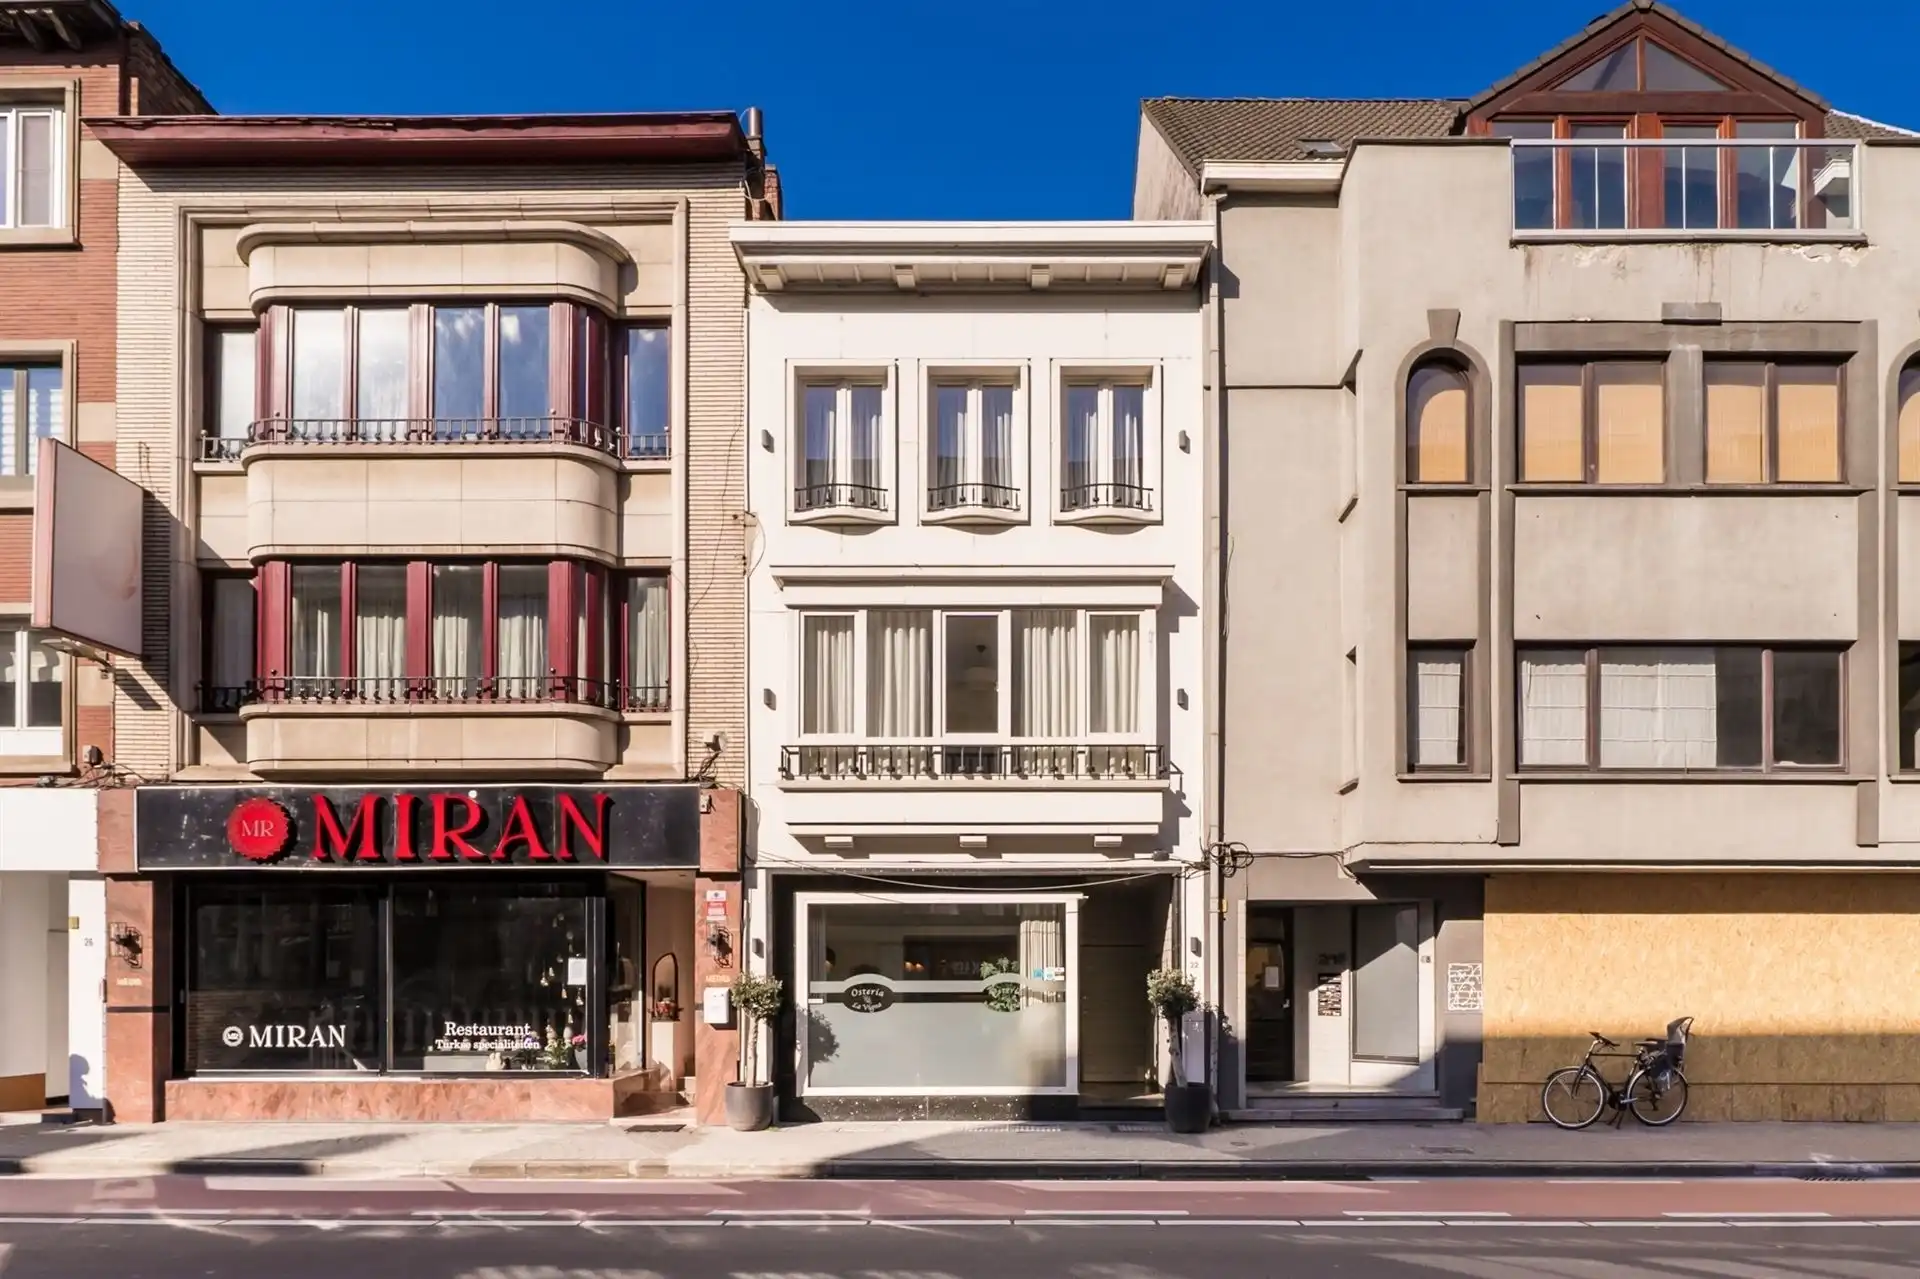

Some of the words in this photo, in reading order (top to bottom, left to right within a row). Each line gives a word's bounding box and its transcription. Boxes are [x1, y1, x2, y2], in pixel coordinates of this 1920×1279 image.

[241, 819, 274, 838] MR
[311, 792, 612, 860] MIRAN
[248, 1024, 346, 1048] MIRAN
[444, 1021, 531, 1036] Restaurant
